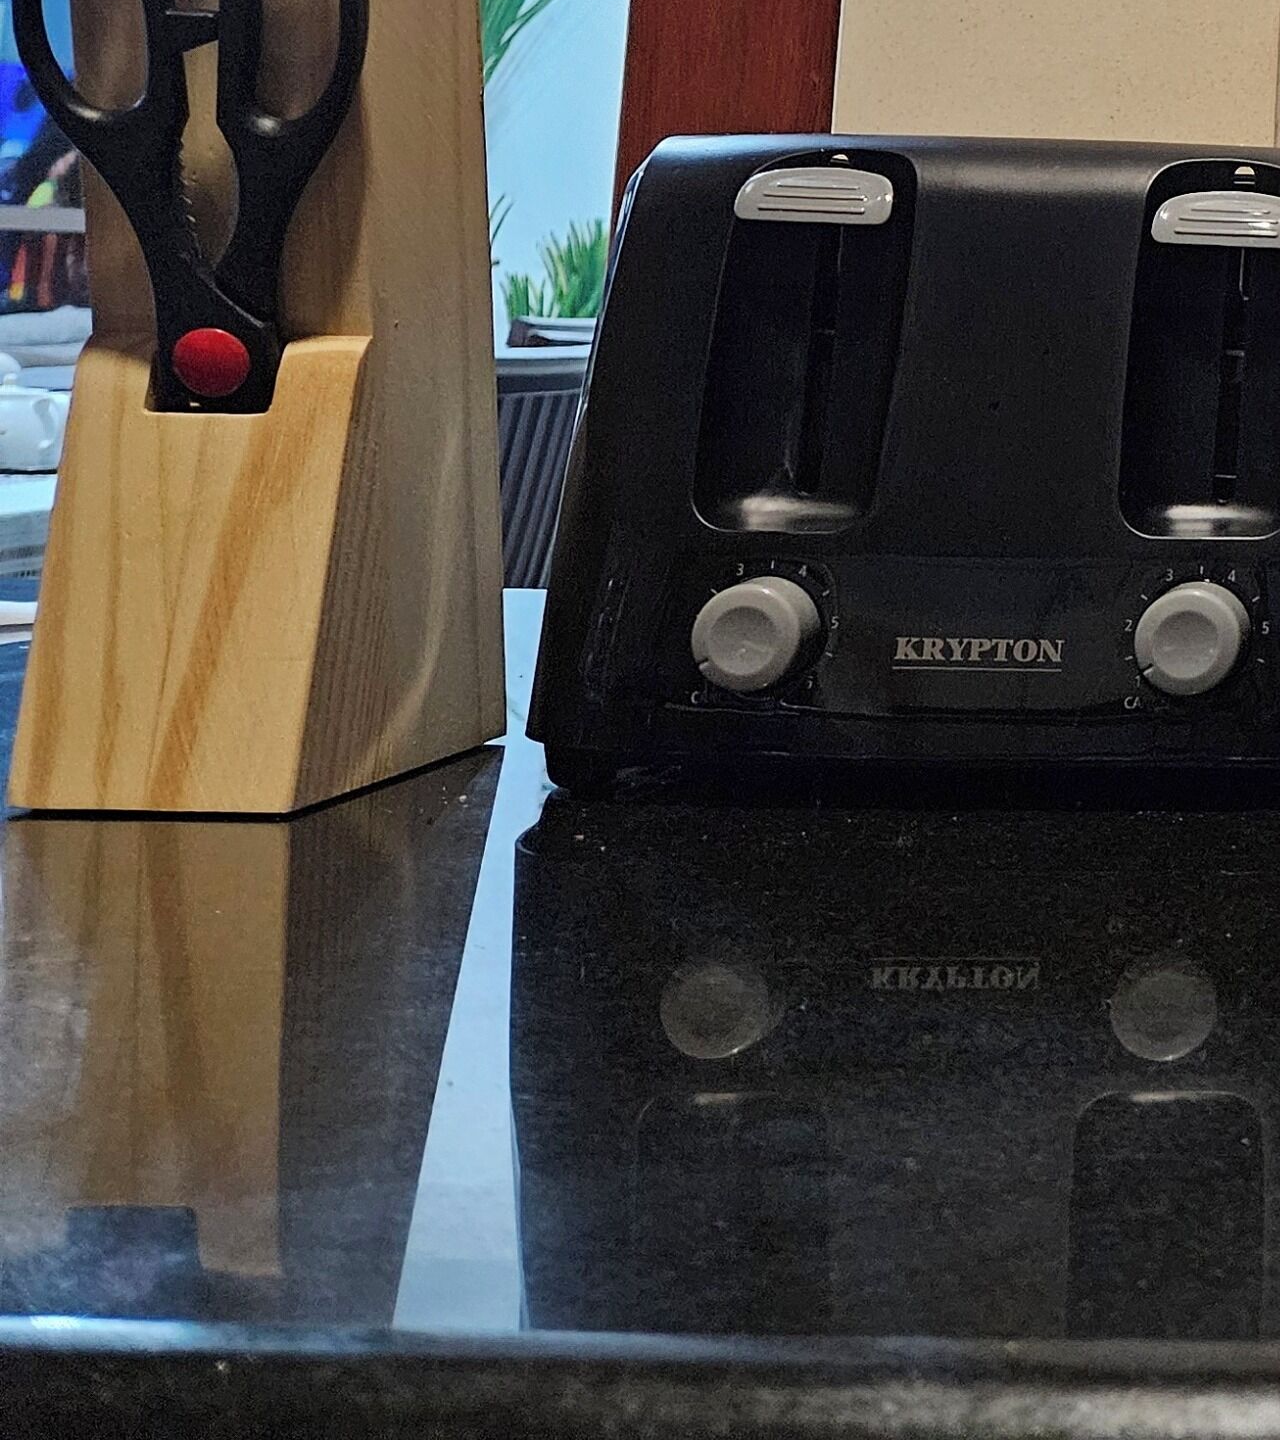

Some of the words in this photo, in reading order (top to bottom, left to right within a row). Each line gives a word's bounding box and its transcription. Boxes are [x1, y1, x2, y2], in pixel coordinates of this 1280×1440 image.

[736, 563, 744, 576] 3
[798, 564, 807, 577] 4
[1165, 568, 1174, 581] 3
[1228, 569, 1236, 582] 4
[831, 616, 839, 629] 5
[1124, 618, 1133, 632] 2
[1262, 621, 1270, 635] 5
[894, 637, 1065, 663] KRYPTON
